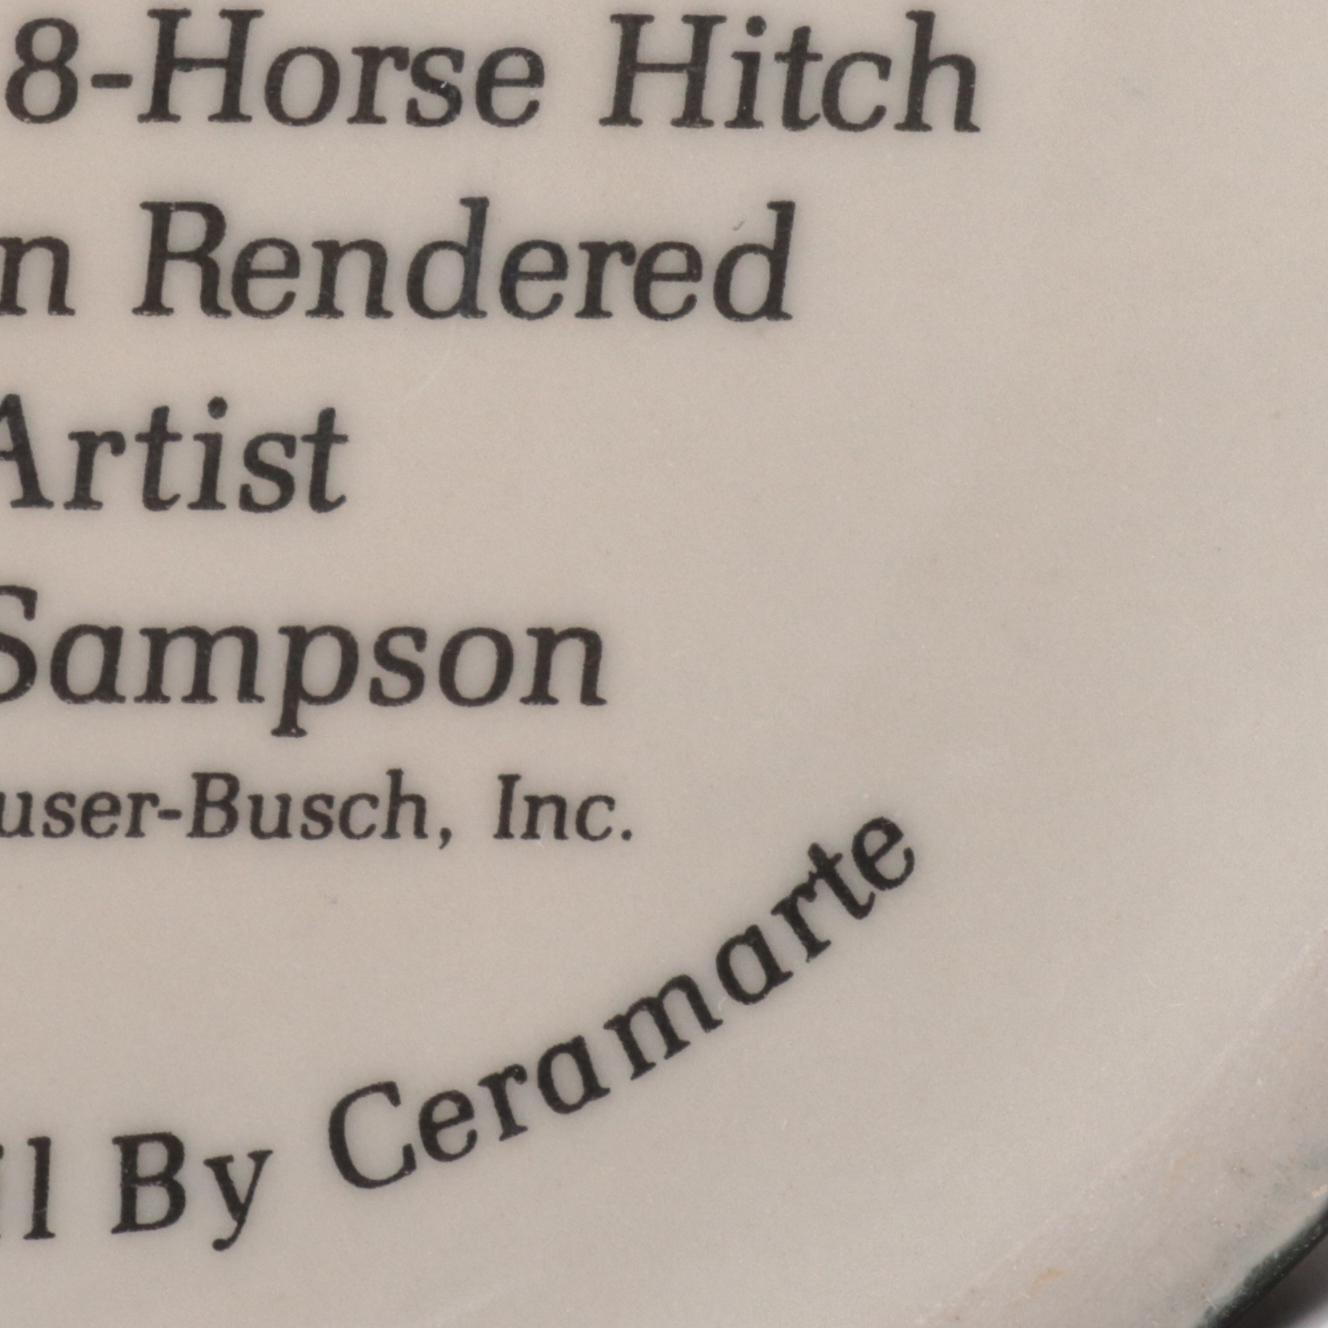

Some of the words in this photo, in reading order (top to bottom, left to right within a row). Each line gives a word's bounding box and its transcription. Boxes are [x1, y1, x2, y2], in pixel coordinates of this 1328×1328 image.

[3, 6, 547, 129] 8-Horse
[597, 8, 982, 135] Hitch
[130, 194, 798, 324] Rendered
[491, 772, 634, 844] Inc.
[109, 1129, 275, 1254] By
[326, 814, 917, 1191] Ceramarte
